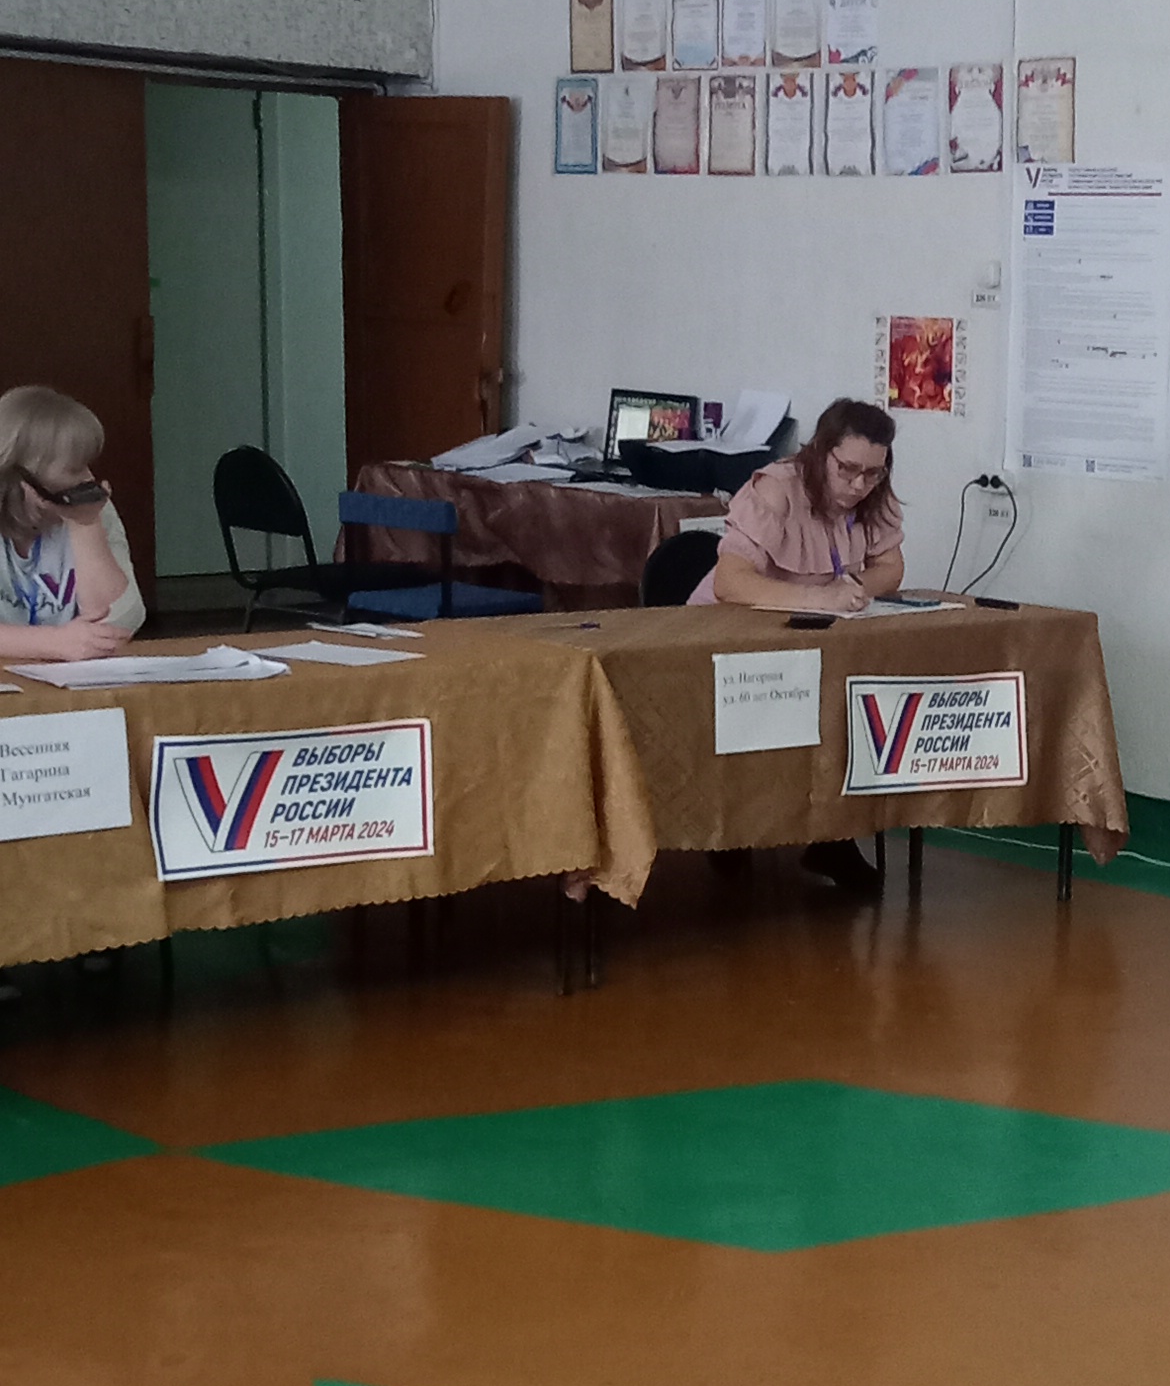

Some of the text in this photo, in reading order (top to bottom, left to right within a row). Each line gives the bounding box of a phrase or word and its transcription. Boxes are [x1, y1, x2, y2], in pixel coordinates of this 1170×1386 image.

[928, 689, 990, 708] ВЫБОРЫ
[921, 711, 1011, 732] ПРЕЗИДЕНТА
[292, 741, 385, 767] ВЫБОРЫ
[914, 734, 970, 754] РОССИИ
[939, 755, 972, 772] МАРТА
[974, 754, 999, 771] 2024
[0, 766, 70, 783] Гагарина
[280, 766, 413, 796] ПРЕЗИДЕНТА
[270, 797, 356, 824] РОССИИ
[306, 823, 356, 844] МАРТА
[357, 820, 395, 840] 2024
